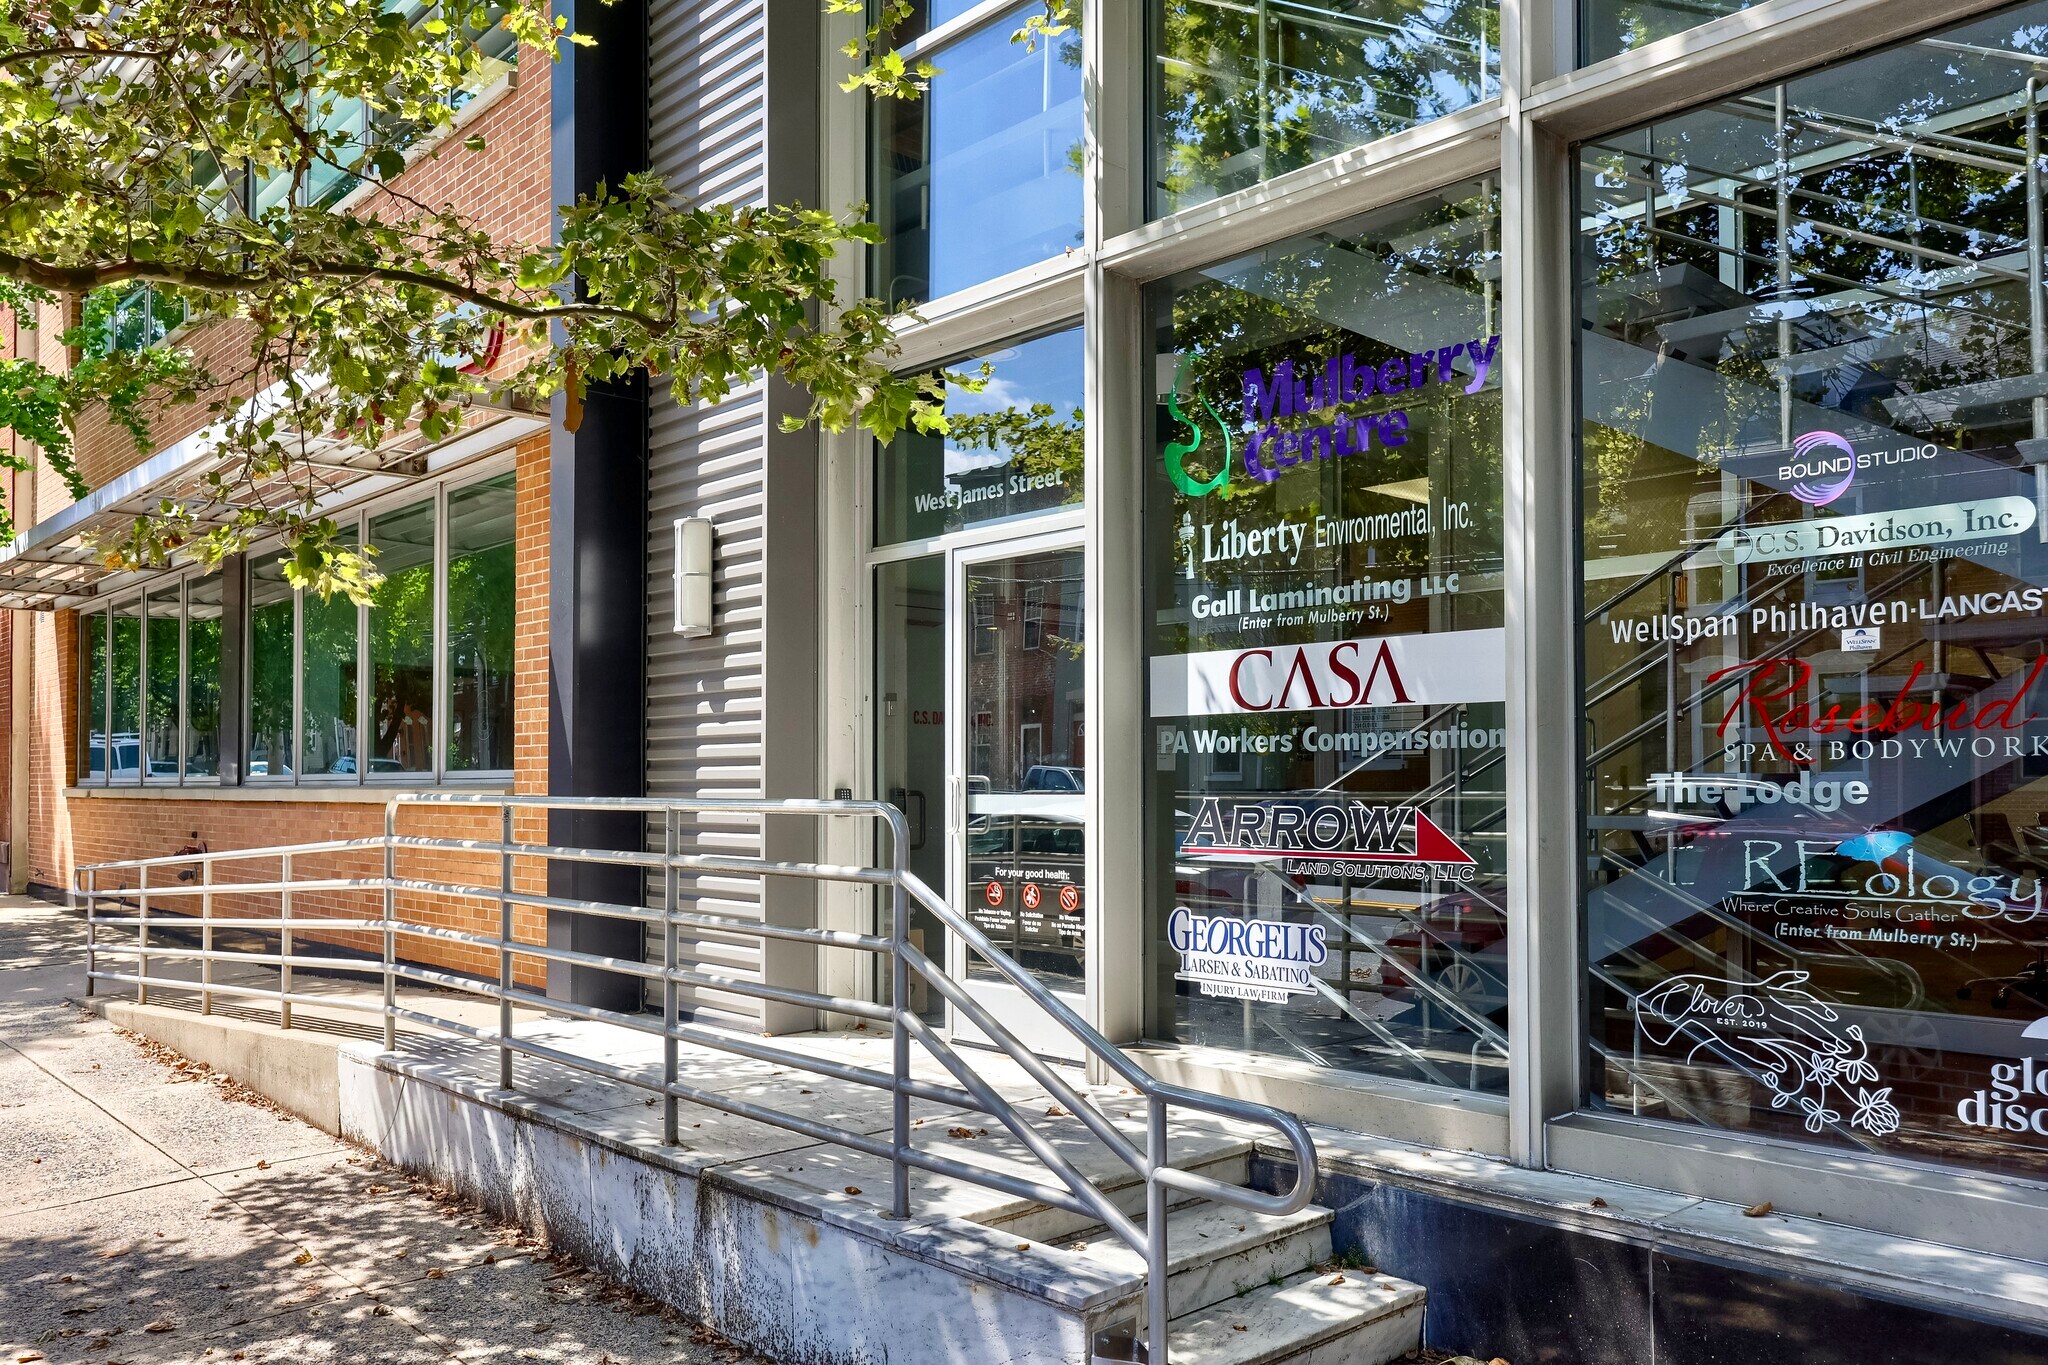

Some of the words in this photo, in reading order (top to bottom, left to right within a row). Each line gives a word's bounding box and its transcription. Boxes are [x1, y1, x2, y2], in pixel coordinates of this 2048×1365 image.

[1243, 335, 1500, 421] Mulberry
[1243, 411, 1409, 482] Centre
[1778, 456, 1852, 481] BOUND
[1857, 444, 1938, 469] STUDIO
[914, 489, 953, 513] West
[957, 482, 1004, 509] James
[1009, 468, 1063, 495] Street
[1202, 518, 1307, 565] Liberty
[1315, 503, 1436, 548] Environmental,
[1443, 497, 1474, 530] Inc.
[1755, 530, 1804, 556] C.S.
[1815, 517, 1953, 549] Davidson,
[1964, 506, 2019, 533] Inc.
[1766, 555, 1846, 577] Excellence
[1849, 555, 1864, 568] in
[1868, 549, 1903, 568] Civil
[1907, 541, 2008, 563] Engineering
[1192, 590, 1240, 619] Gall
[1249, 575, 1411, 613] Laminating
[1420, 573, 1460, 596] LLC
[1238, 613, 1275, 633] (Enter
[1277, 613, 1304, 626] from
[1308, 607, 1364, 628] Mulberry
[1368, 604, 1390, 621] St.)
[1611, 612, 1738, 646] WellSpan
[1229, 640, 1416, 711] CASA
[913, 711, 931, 725] C.S.
[1707, 654, 2047, 764] Rosebud
[1160, 730, 1189, 754] PA
[1193, 727, 1297, 754] Workers'
[1302, 722, 1506, 758] Compensation
[1724, 741, 1778, 763] SPA
[1793, 741, 1813, 761] &
[1829, 735, 2048, 760] BODYWORK
[1655, 772, 1723, 803] The
[1735, 771, 1869, 811] Lodge
[1183, 797, 1412, 852] ARROW
[995, 867, 1007, 876] For
[1008, 868, 1024, 878] your
[1025, 869, 1044, 879] good
[1045, 869, 1070, 880] health:
[1286, 858, 1330, 876] LAND
[1332, 860, 1430, 881] SOLUTIONS,
[1433, 863, 1476, 882] LLC
[1741, 840, 2042, 922] REology
[1722, 897, 1771, 913] Where
[1773, 898, 1839, 916] Creative
[1842, 902, 1892, 920] Souls
[1895, 905, 1958, 923] Gather
[1169, 908, 1327, 964] GEORGELIS
[1774, 922, 1822, 940] (Enter
[1825, 924, 1863, 941] from
[1869, 926, 1943, 948] Mulberry
[1950, 931, 1978, 951] St.)
[1182, 953, 1230, 977] LARSEN
[1231, 962, 1241, 977] &
[1244, 959, 1310, 985] SABATINO
[1202, 984, 1235, 996] INJURY
[1238, 986, 1261, 998] LAW
[1262, 989, 1287, 1002] FIRM
[1650, 983, 1764, 1022] Clover
[1716, 1017, 1738, 1026] EST.
[1742, 1020, 1767, 1029] 2019
